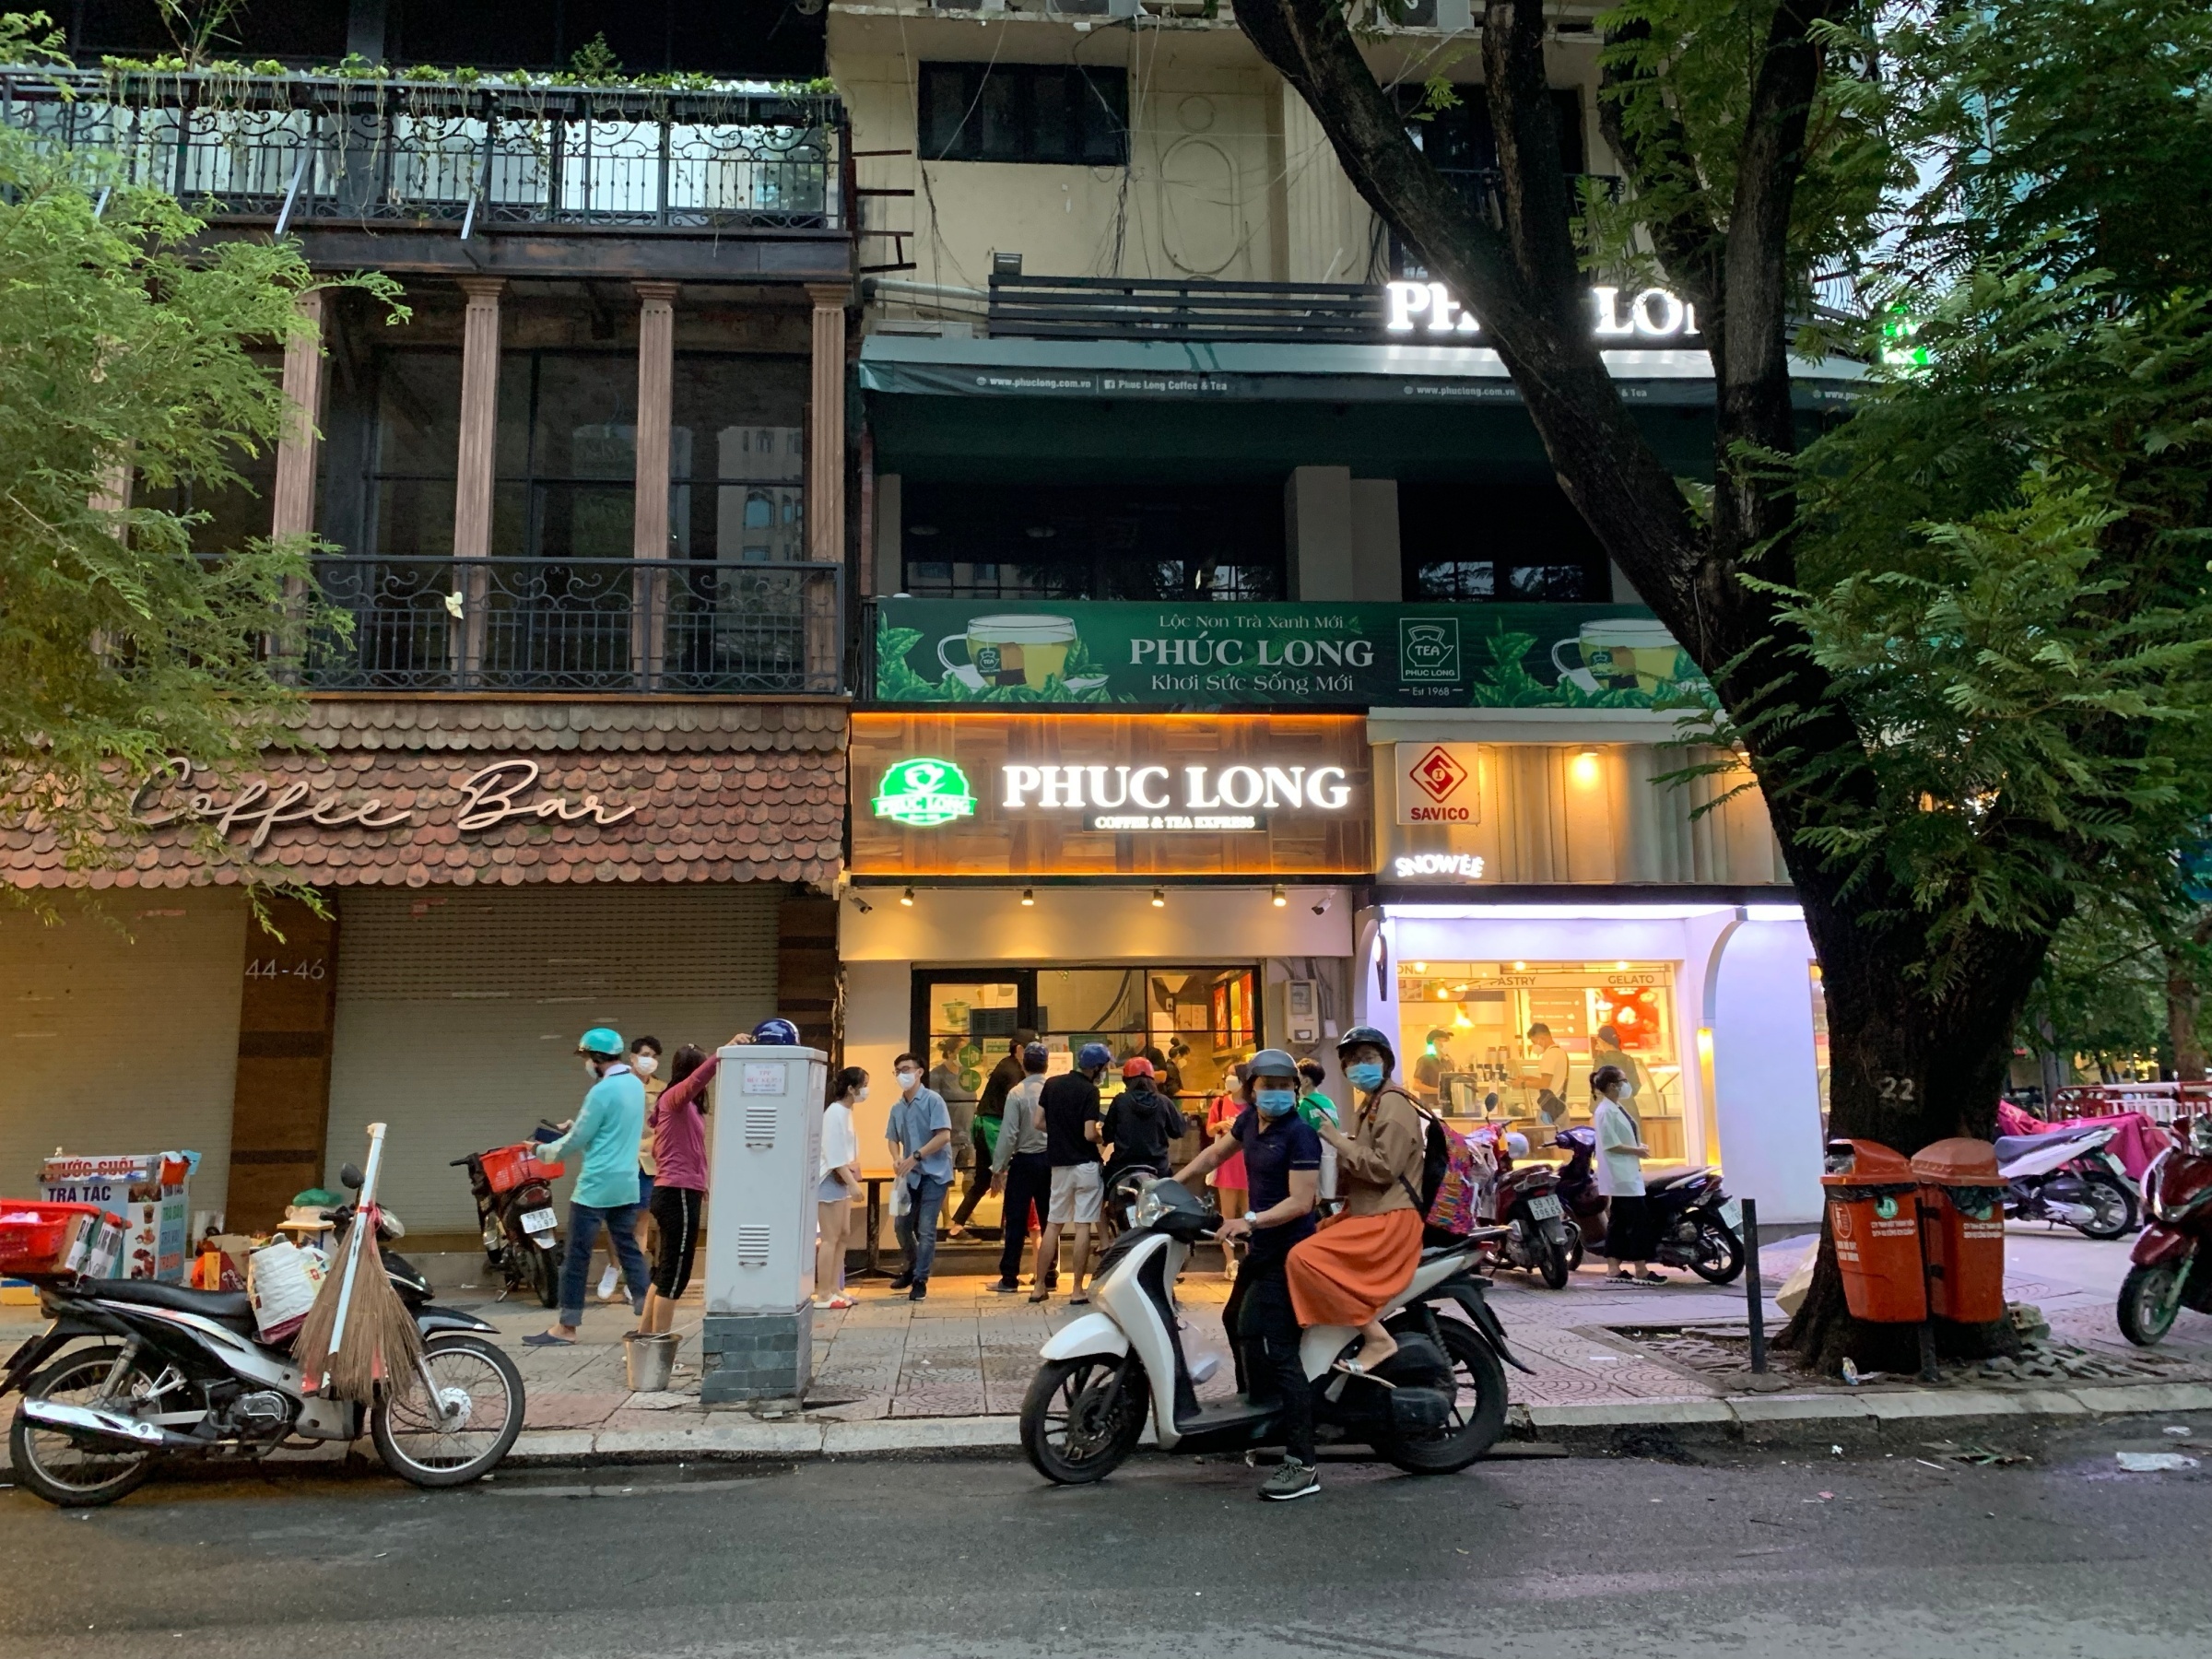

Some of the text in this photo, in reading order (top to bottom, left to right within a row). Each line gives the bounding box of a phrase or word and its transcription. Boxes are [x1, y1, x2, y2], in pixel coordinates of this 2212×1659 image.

[990, 377, 1091, 390] www.phuclong.com.vn
[1118, 380, 1228, 392] Phuc Long Coffee & Tea
[1417, 386, 1516, 398] www.phuclong.com.vn
[1621, 388, 1648, 397] & Tea
[1159, 613, 1344, 629] Lộc Non Trà Xanh Mới
[1129, 630, 1375, 667] PHÚC LONG
[1415, 645, 1440, 656] TEA
[1152, 671, 1353, 695] Khơi Sức Sống Mới
[1412, 687, 1450, 696] Est 1968
[1002, 765, 1351, 809] PHUC LONG
[457, 759, 636, 830] Bar
[1410, 806, 1469, 820] SAVICO
[1094, 816, 1255, 829] COFFEE & TEA EXPRESS
[244, 959, 325, 981] 44-46
[1607, 974, 1654, 984] GELATO
[1880, 1076, 1914, 1101] 22
